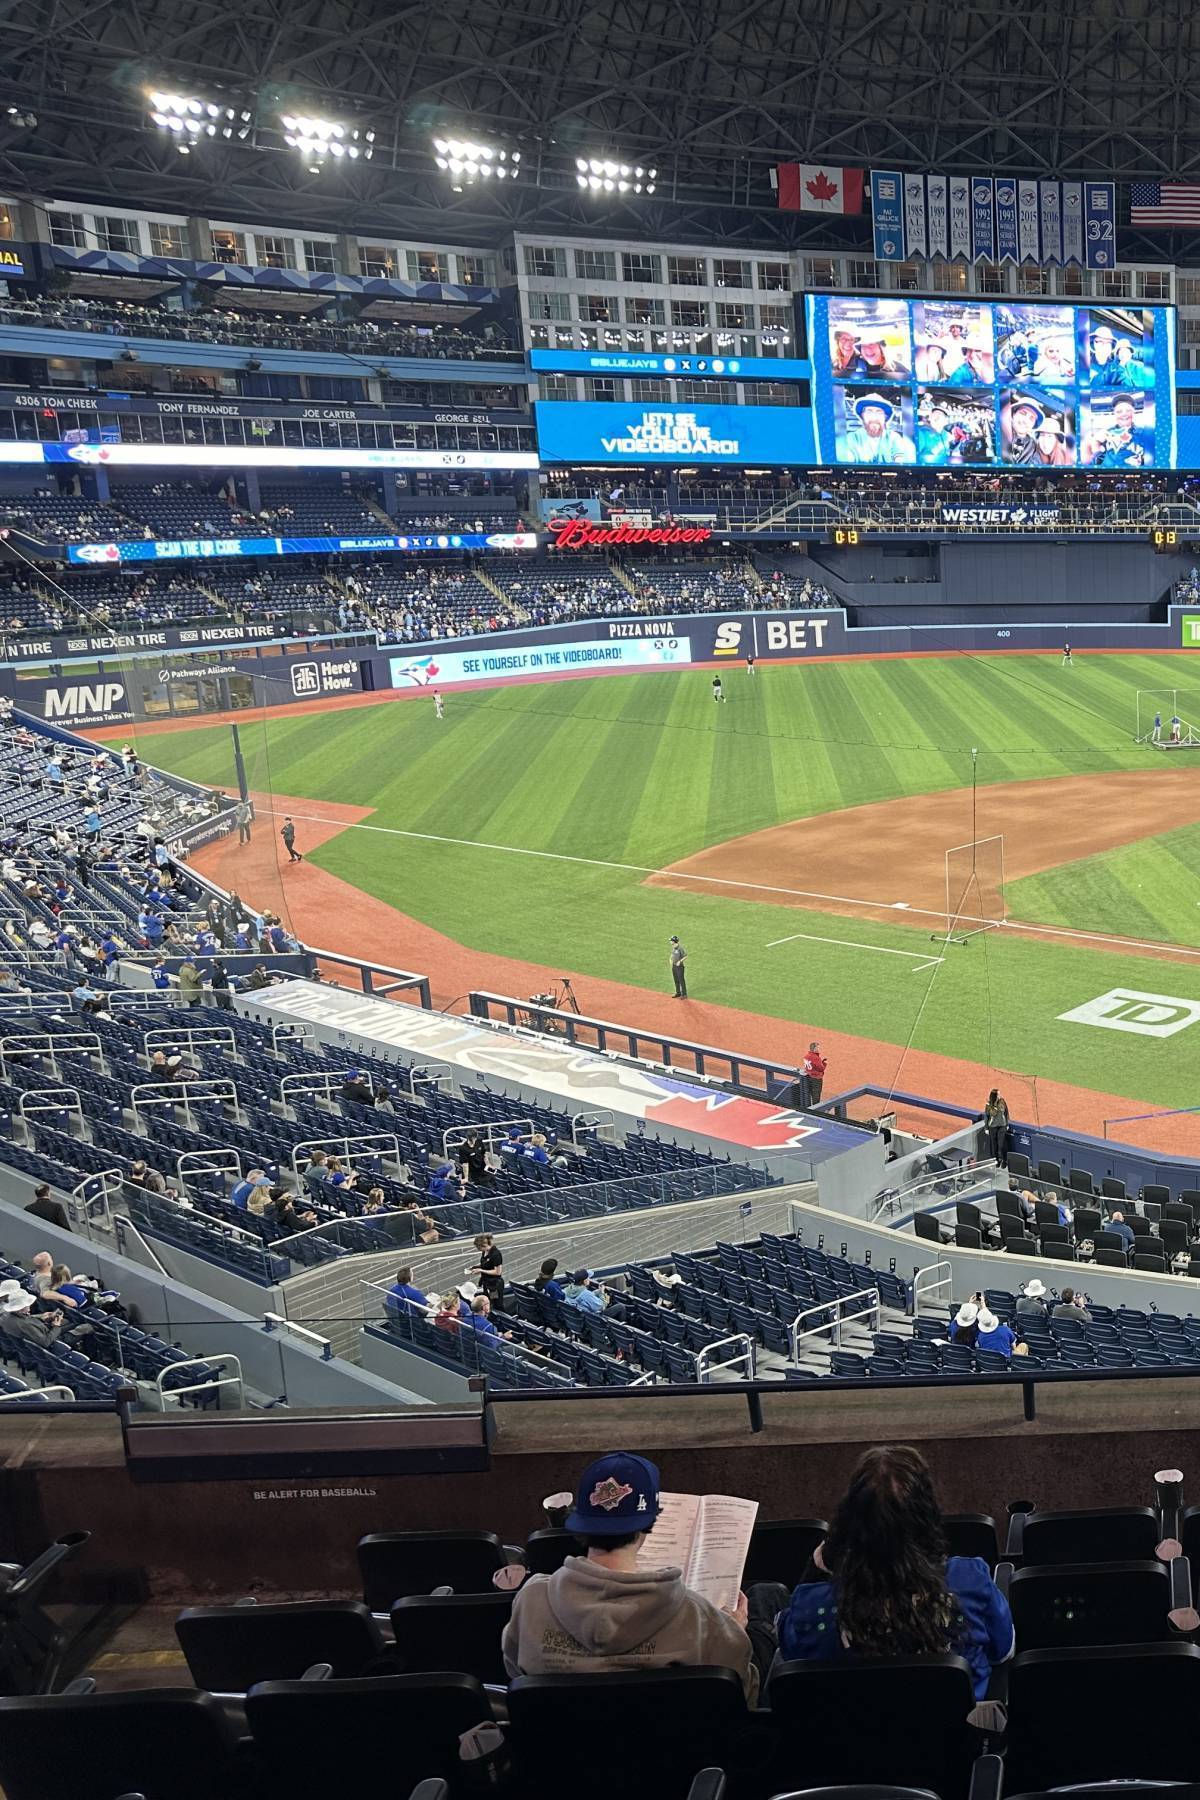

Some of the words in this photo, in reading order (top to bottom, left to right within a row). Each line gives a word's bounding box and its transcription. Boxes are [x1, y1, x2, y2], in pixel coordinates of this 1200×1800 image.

[908, 205, 923, 216] 1985
[930, 206, 944, 217] 1989
[953, 208, 967, 219] 1991
[975, 208, 990, 220] 1992
[999, 210, 1014, 221] 1993
[1021, 211, 1036, 222] 2015
[1087, 219, 1113, 241] 32
[15, 395, 40, 406] 4306
[42, 397, 65, 407] TOM
[67, 398, 97, 409] CHEEK
[157, 403, 183, 413] TONY
[187, 404, 240, 415] FERNANDEZ
[302, 410, 320, 419] JOE
[323, 410, 356, 419] CARTER
[434, 414, 469, 423] GEORGE
[472, 415, 491, 423] BELL
[643, 413, 673, 426] LET'S
[674, 413, 696, 427] SEE
[627, 426, 671, 440] YOU
[601, 438, 739, 454] VIDEOBOARD!
[548, 519, 712, 549] Budweiser
[1155, 532, 1175, 544] 0:13
[202, 628, 244, 640] NEXEN
[244, 624, 274, 638] TIRE
[609, 624, 642, 637] PIZZA
[645, 622, 674, 636] NOVA
[715, 621, 742, 648] S
[767, 620, 828, 649] BET
[91, 636, 135, 649] NEXEN
[138, 633, 166, 645] TIRE
[20, 642, 52, 655] TIRE
[321, 660, 357, 675] Here's
[463, 660, 481, 673] SEE
[484, 656, 528, 671] YOURSELF
[530, 654, 542, 667] ON
[545, 653, 560, 665] THE
[563, 648, 622, 664] VIDEOBOARD!
[171, 668, 206, 679] Pathways
[208, 666, 236, 674] Alliance
[322, 676, 353, 690] How.
[44, 683, 124, 717] MNP
[1100, 996, 1192, 1026] TD
[254, 1492, 267, 1500] BE
[269, 1490, 298, 1499] ALERT
[300, 1489, 320, 1497] FOR
[321, 1488, 376, 1497] BASEBALLS
[637, 1494, 647, 1511] LA
